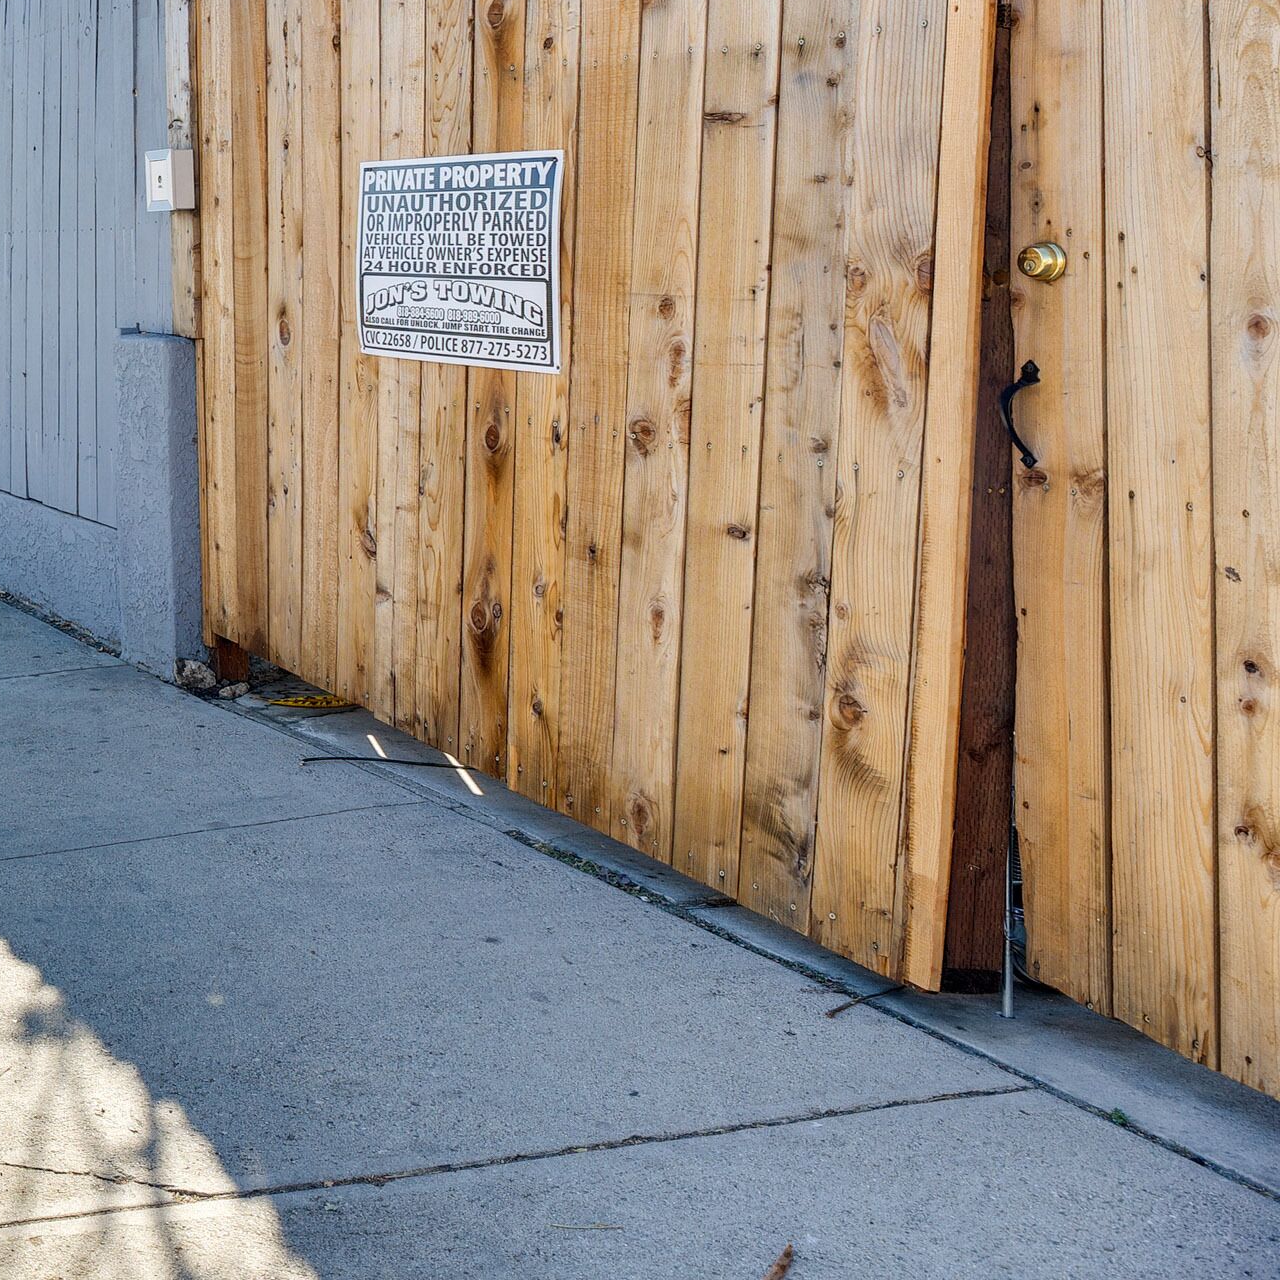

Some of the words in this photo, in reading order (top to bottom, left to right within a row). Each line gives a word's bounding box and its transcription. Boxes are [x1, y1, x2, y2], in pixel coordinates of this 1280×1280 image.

[364, 168, 435, 192] PRIVATE
[440, 161, 553, 189] PROPERTY
[367, 190, 547, 213] UNAUTHORIZED
[367, 213, 384, 232] OR
[388, 212, 478, 232] IMPROPERLY
[482, 210, 547, 231] PARKED
[365, 233, 424, 246] VEHICLES
[428, 233, 463, 246] WILL
[467, 233, 485, 246] BE
[489, 233, 547, 247] TOWED
[364, 247, 376, 260] AT
[378, 247, 423, 260] VEHICLE
[426, 247, 483, 261] OWNER'S
[489, 248, 547, 263] EXPENSE
[364, 261, 383, 271] 24
[389, 261, 436, 273] HOUR
[443, 263, 547, 277] ENFORCED
[366, 280, 427, 314] JON'S
[433, 279, 543, 327] TOWING
[366, 316, 379, 324] ALSO
[381, 317, 395, 325] CALL
[442, 322, 462, 330] JUMP
[492, 325, 509, 334] TIRE
[512, 326, 545, 337] CHANGE
[447, 308, 501, 324] 818-989-6000
[365, 330, 380, 345] CVC
[382, 332, 411, 348] 22658
[413, 335, 418, 349] /
[421, 336, 458, 353] POLICE
[461, 340, 547, 361] 877-275-5273
